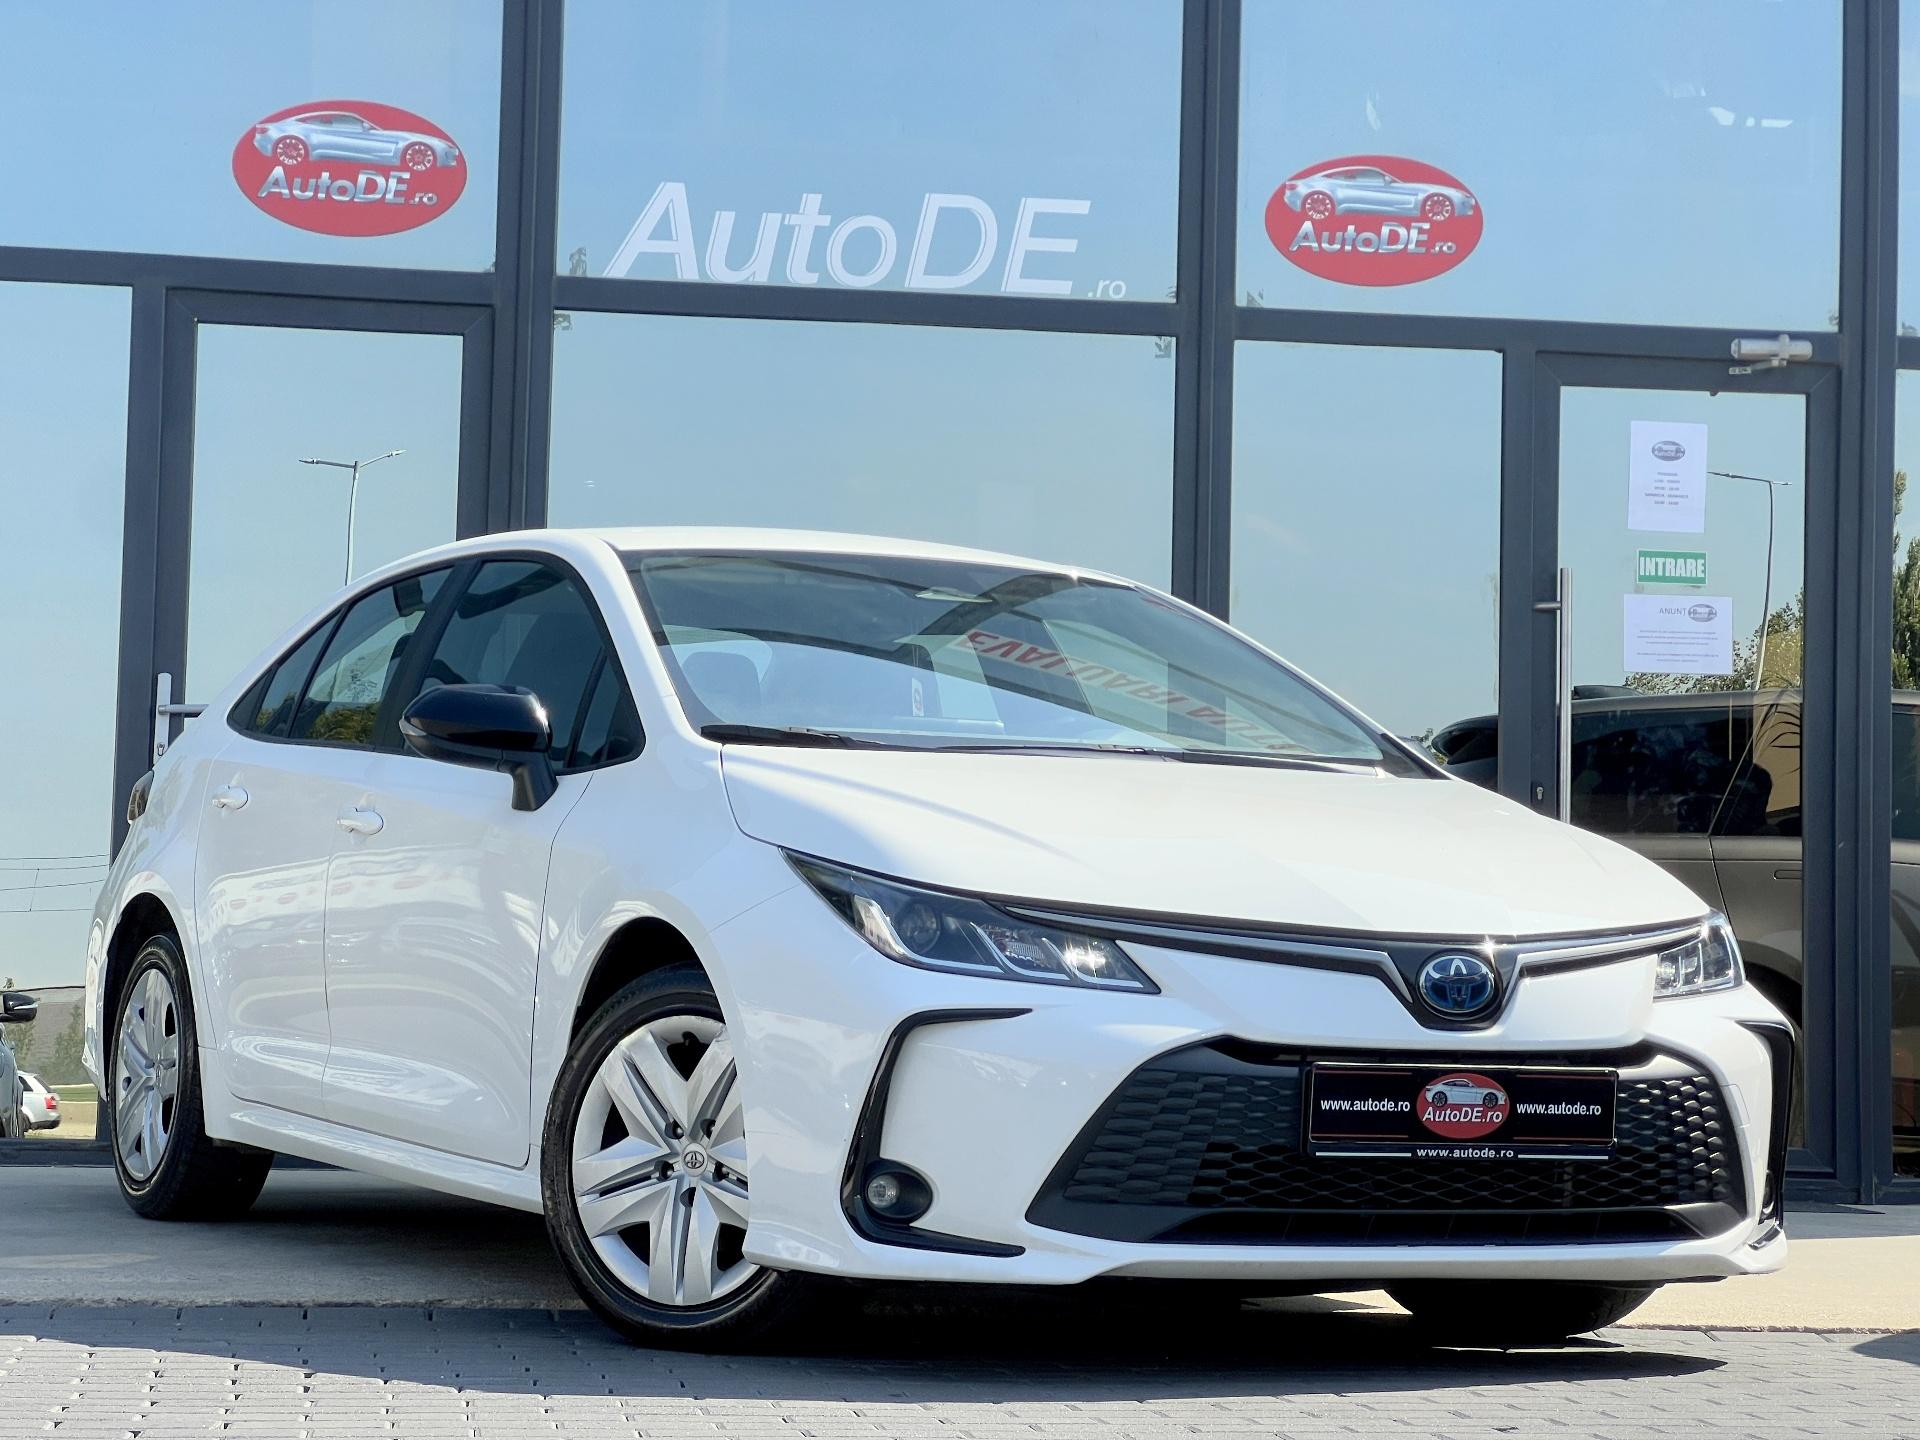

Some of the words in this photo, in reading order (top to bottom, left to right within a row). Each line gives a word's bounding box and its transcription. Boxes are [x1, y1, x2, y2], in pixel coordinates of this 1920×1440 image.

[1639, 556, 1705, 578] INTRARE
[1320, 1097, 1411, 1112] www.autode.ro
[1422, 1106, 1503, 1123] AutoDE.ro
[1516, 1101, 1602, 1116] www.autode.ro
[1416, 1147, 1515, 1159] www.autode.ro
